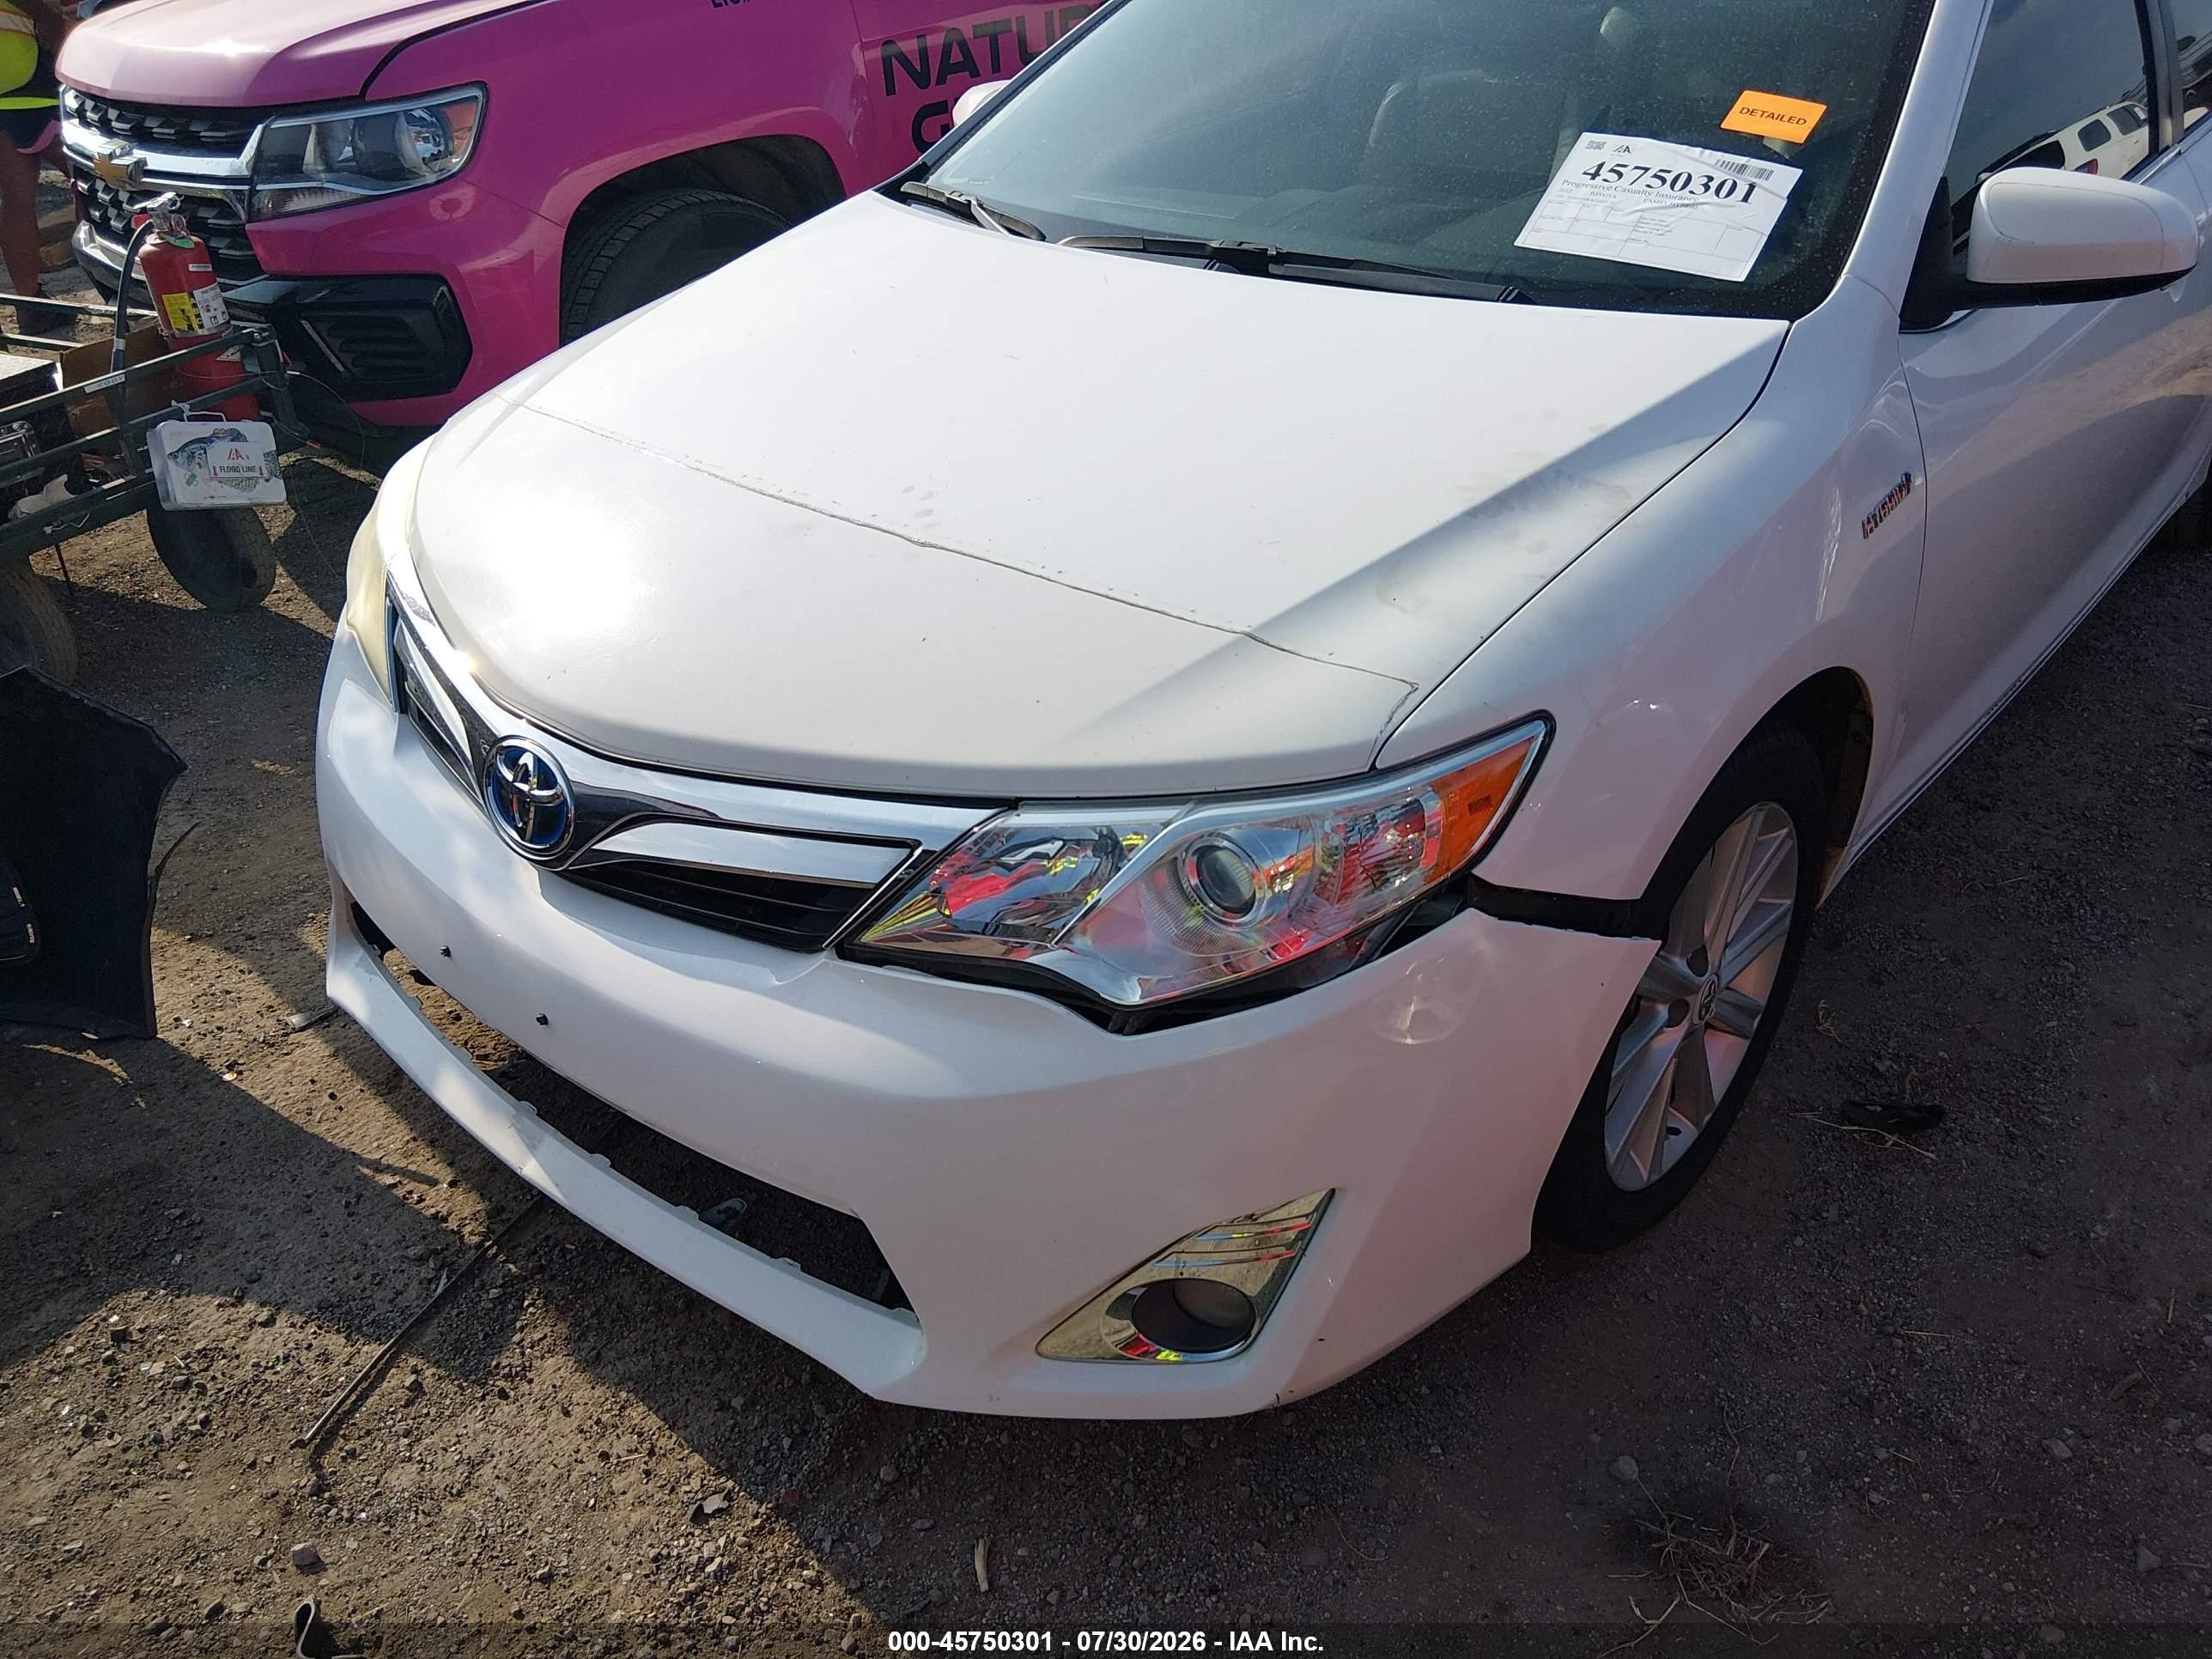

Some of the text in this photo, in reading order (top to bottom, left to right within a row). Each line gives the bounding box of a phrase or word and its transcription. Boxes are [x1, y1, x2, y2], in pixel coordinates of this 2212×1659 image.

[1738, 106, 1808, 126] DETAILED
[1561, 179, 1612, 191] Progressive
[1613, 185, 1653, 197] Casualty
[1582, 161, 1758, 204] 45750301
